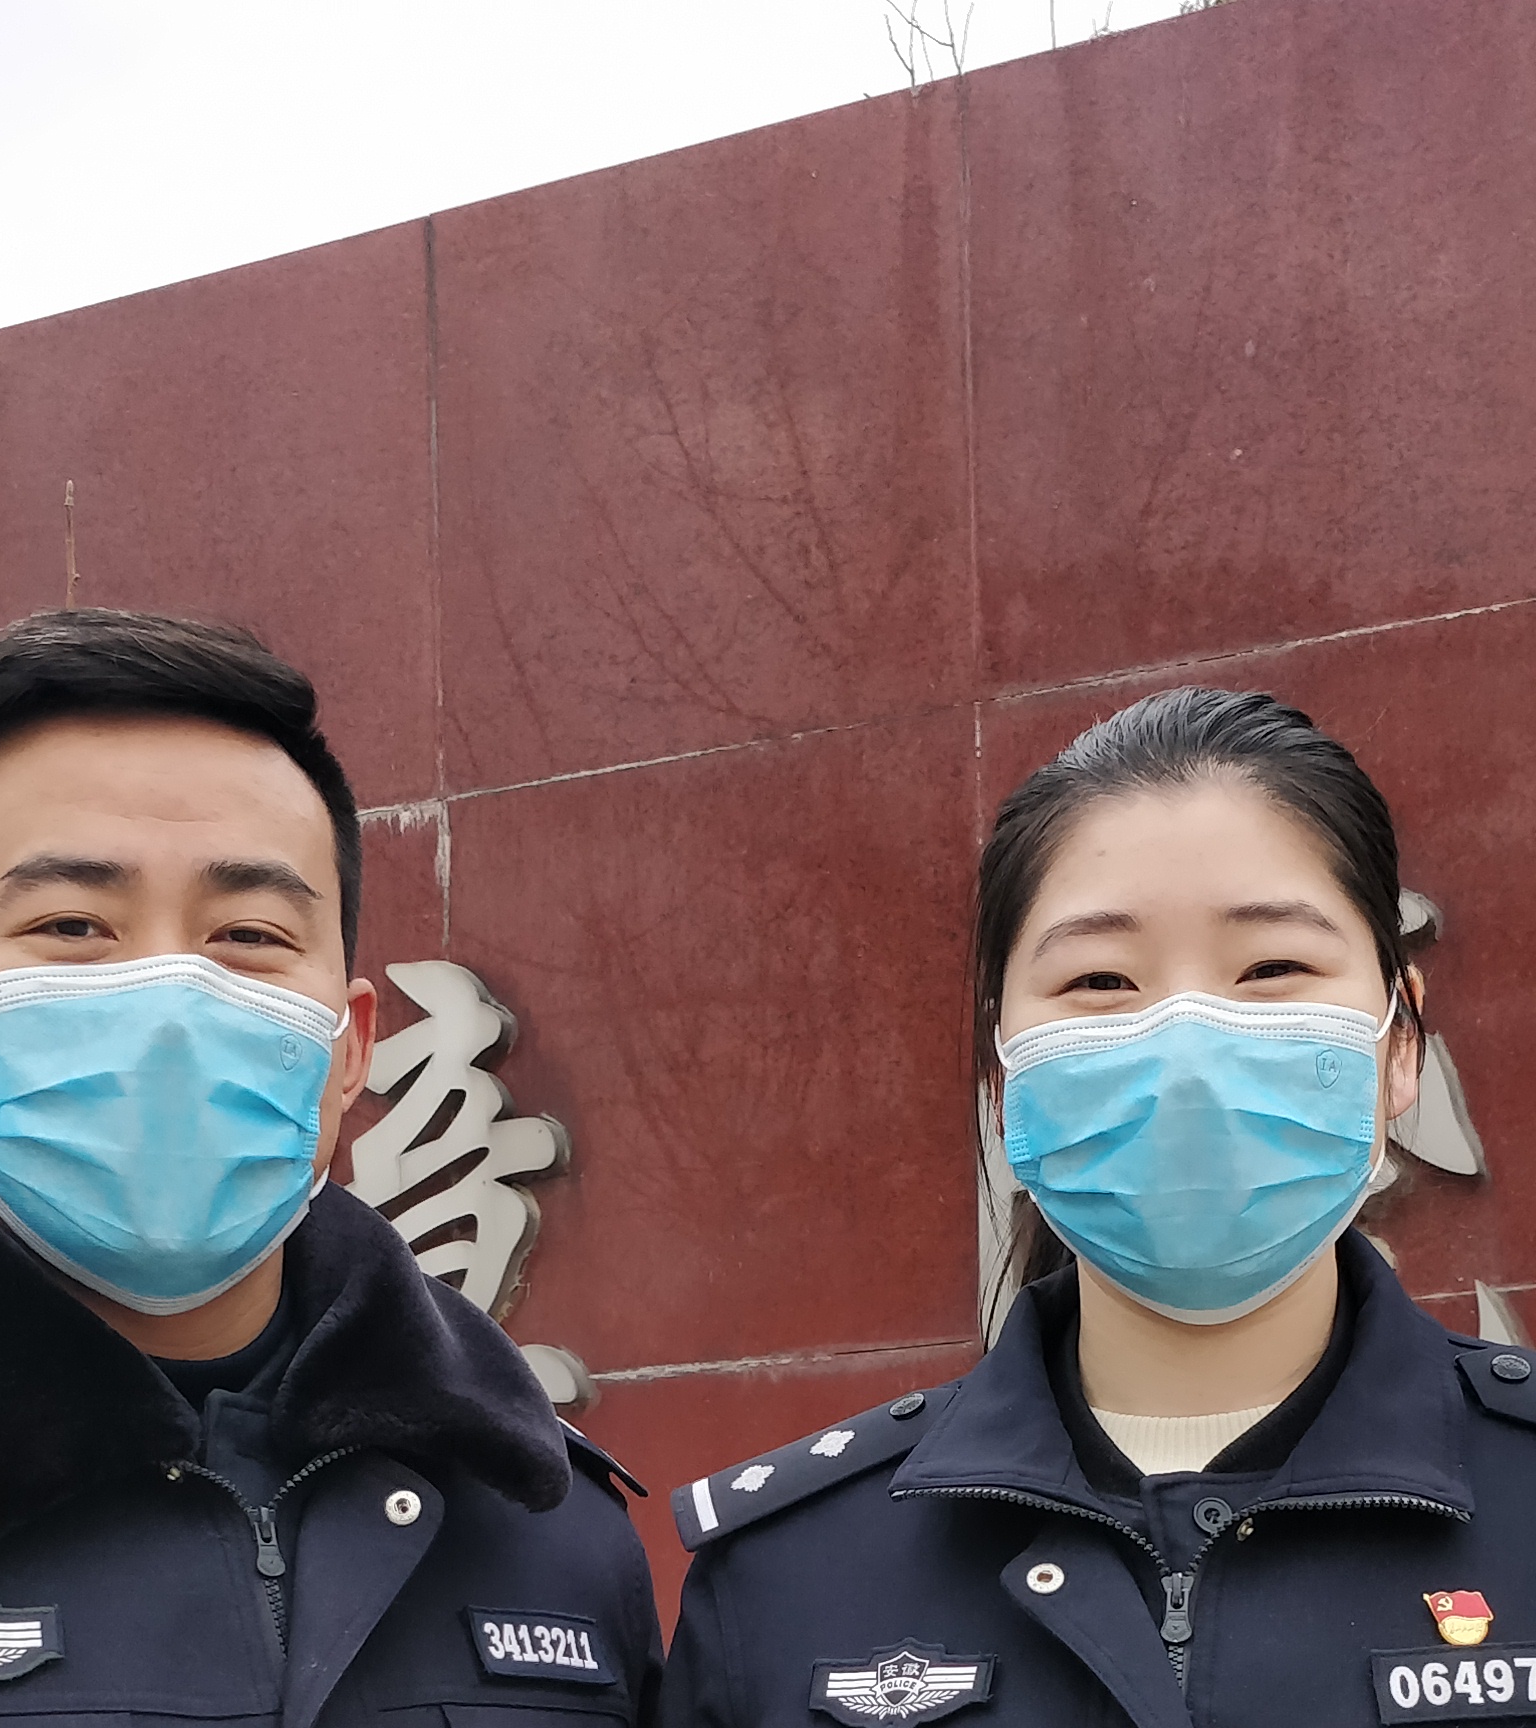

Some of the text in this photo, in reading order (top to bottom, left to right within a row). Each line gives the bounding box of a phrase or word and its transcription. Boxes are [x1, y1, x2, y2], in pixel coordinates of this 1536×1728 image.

[483, 1622, 599, 1670] 3413211
[883, 1663, 920, 1677] 安徽
[881, 1681, 917, 1691] POLICE
